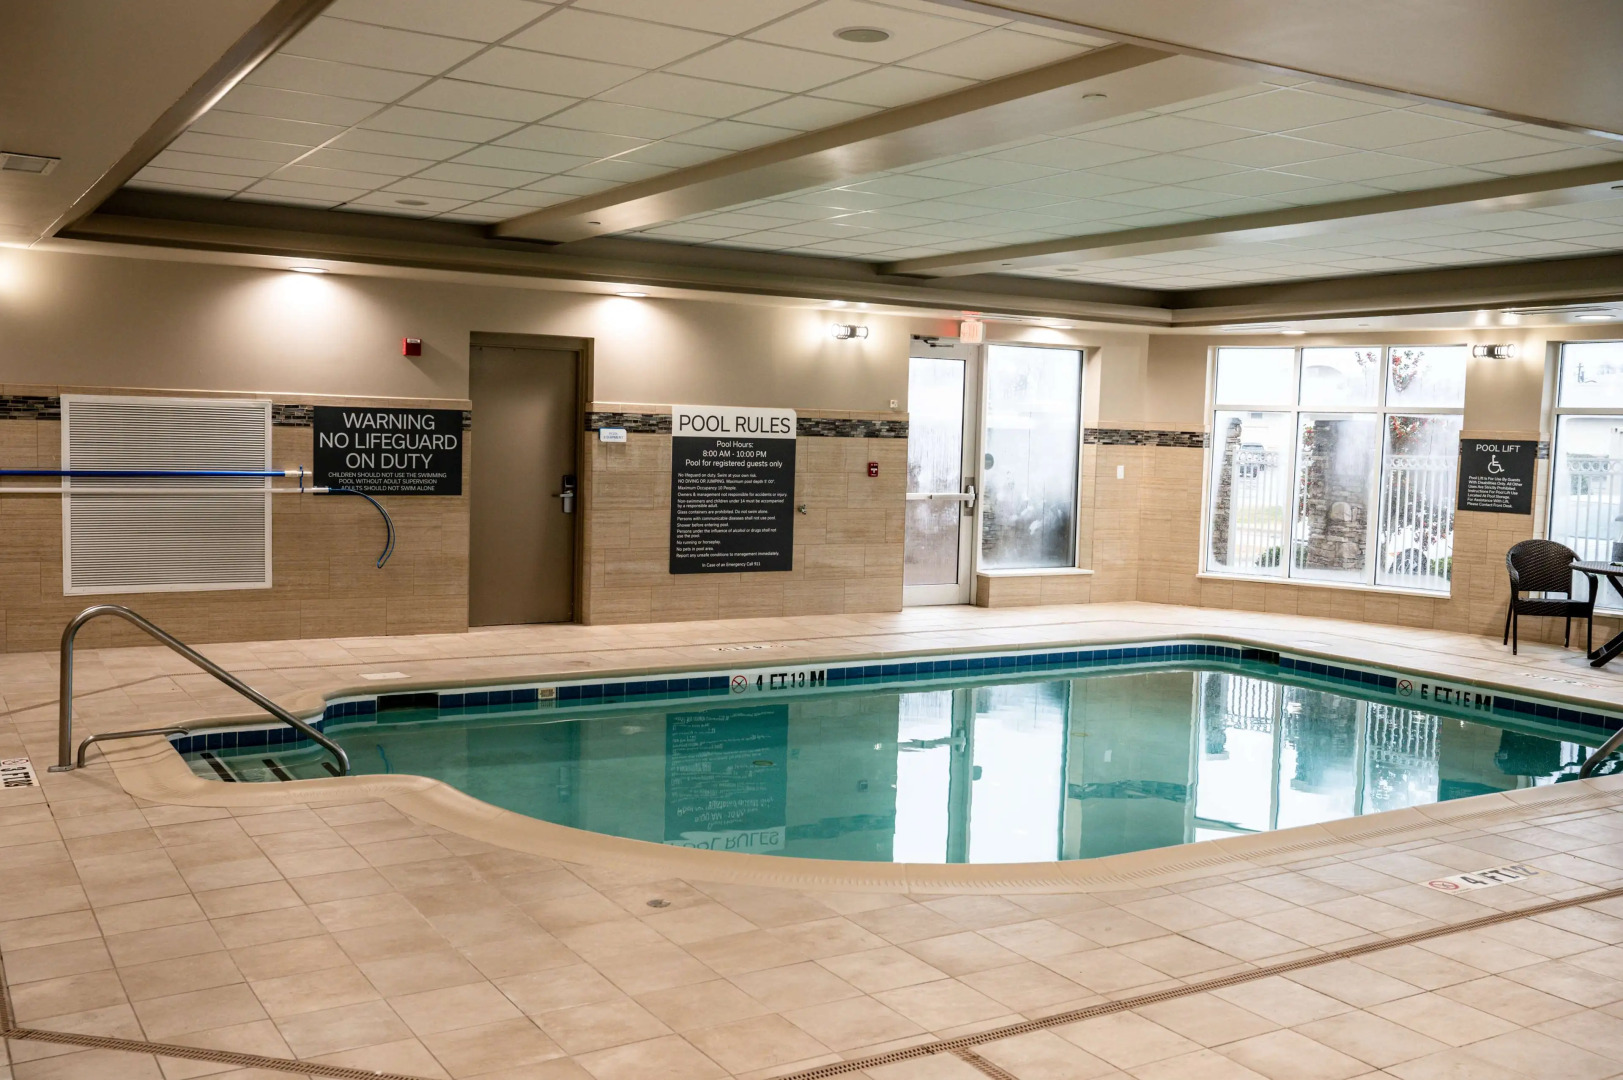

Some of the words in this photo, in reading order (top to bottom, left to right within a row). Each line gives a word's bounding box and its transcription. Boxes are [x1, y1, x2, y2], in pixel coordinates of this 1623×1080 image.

[343, 413, 435, 430] WARNING
[679, 415, 730, 432] POOL
[736, 416, 791, 434] RULES
[319, 432, 349, 448] NO
[355, 433, 458, 450] LIFEGUARD
[1476, 444, 1500, 452] POOL
[346, 453, 374, 469] ON
[381, 453, 433, 469] DUTY
[713, 460, 745, 468] registered
[1460, 876, 1488, 885] 4
